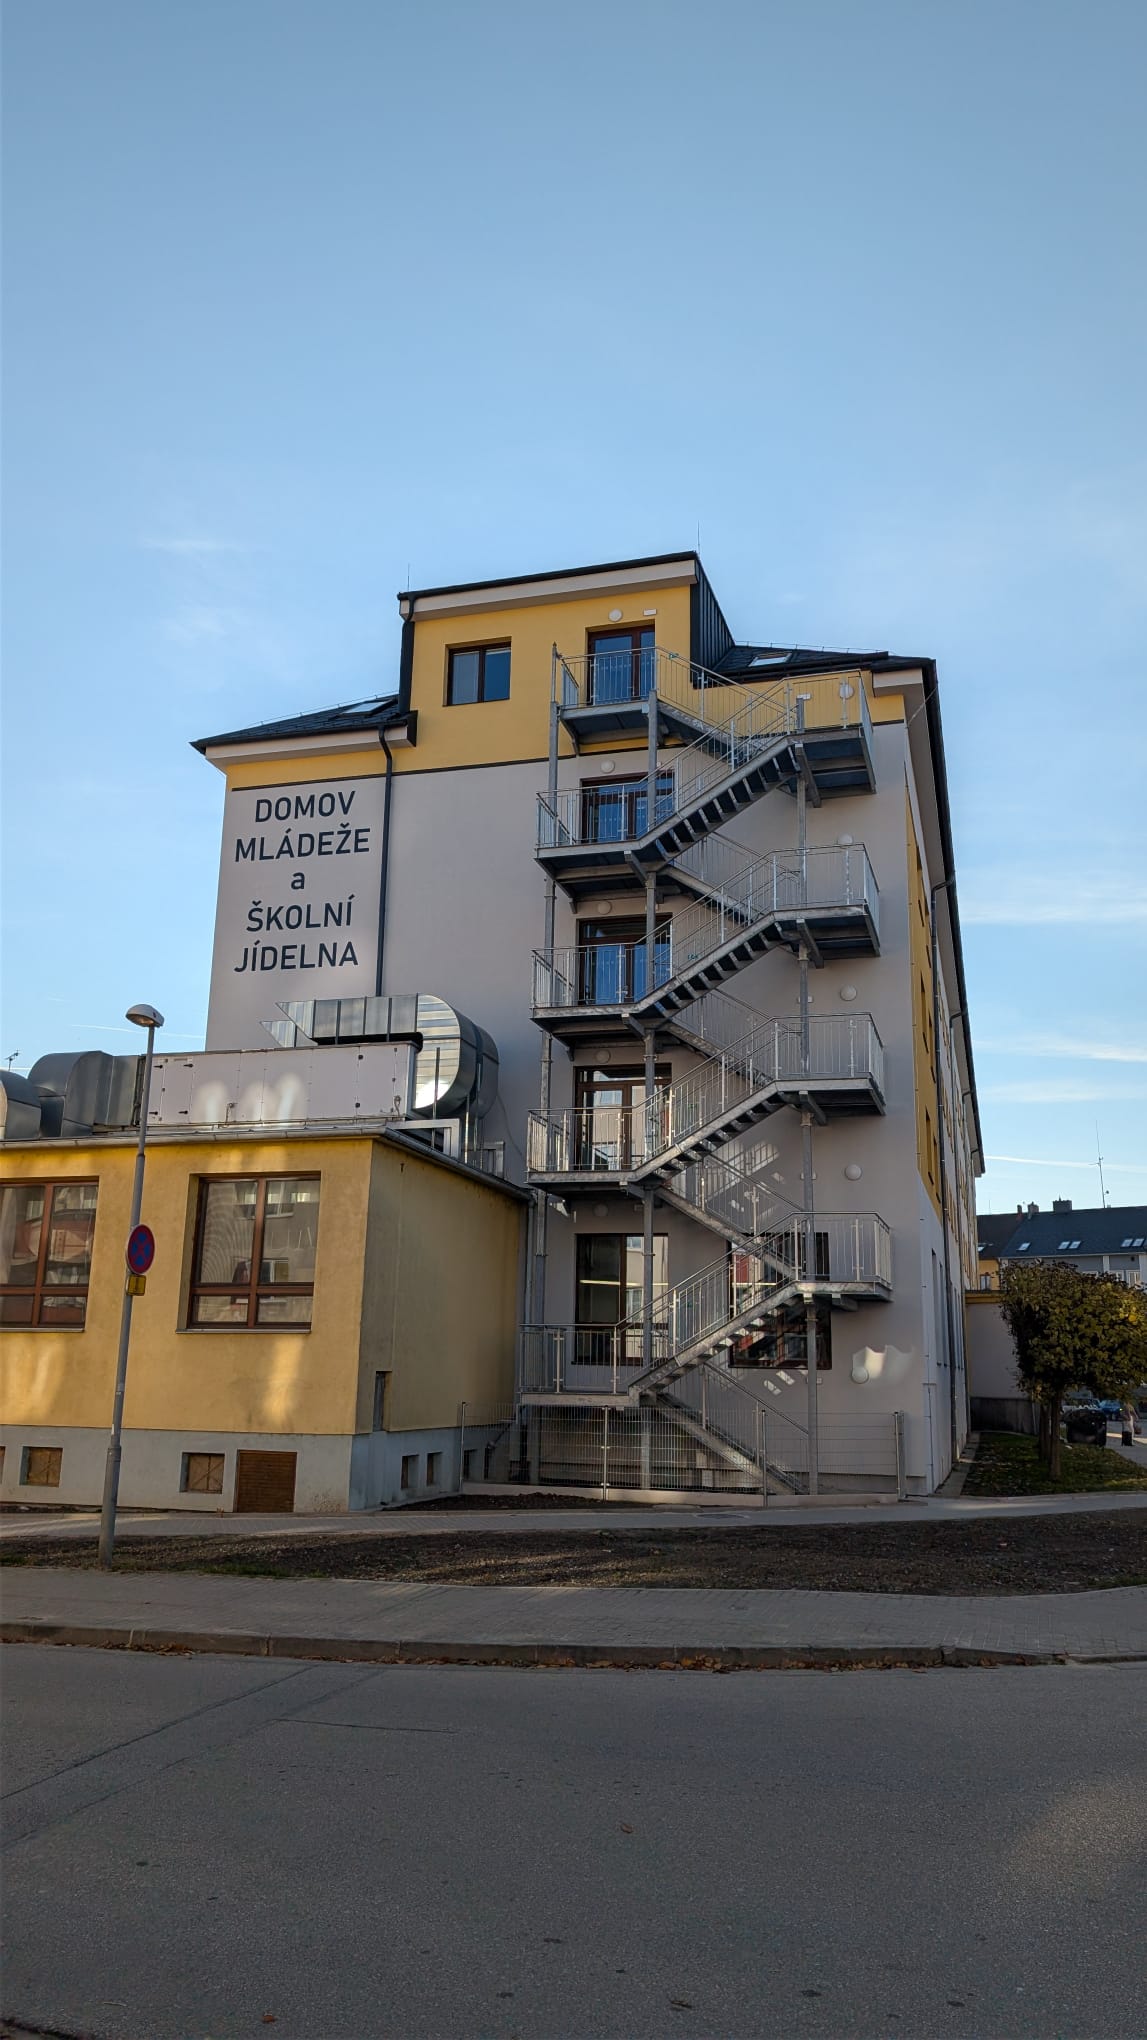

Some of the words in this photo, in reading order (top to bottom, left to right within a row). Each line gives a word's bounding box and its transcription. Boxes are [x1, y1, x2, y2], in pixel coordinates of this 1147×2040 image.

[255, 790, 355, 822] DOMOV
[235, 822, 371, 862] MLÁDEŽE
[290, 872, 305, 890] a
[246, 894, 355, 932] ŠKOLNÍ
[234, 940, 359, 973] JÍDELNA
